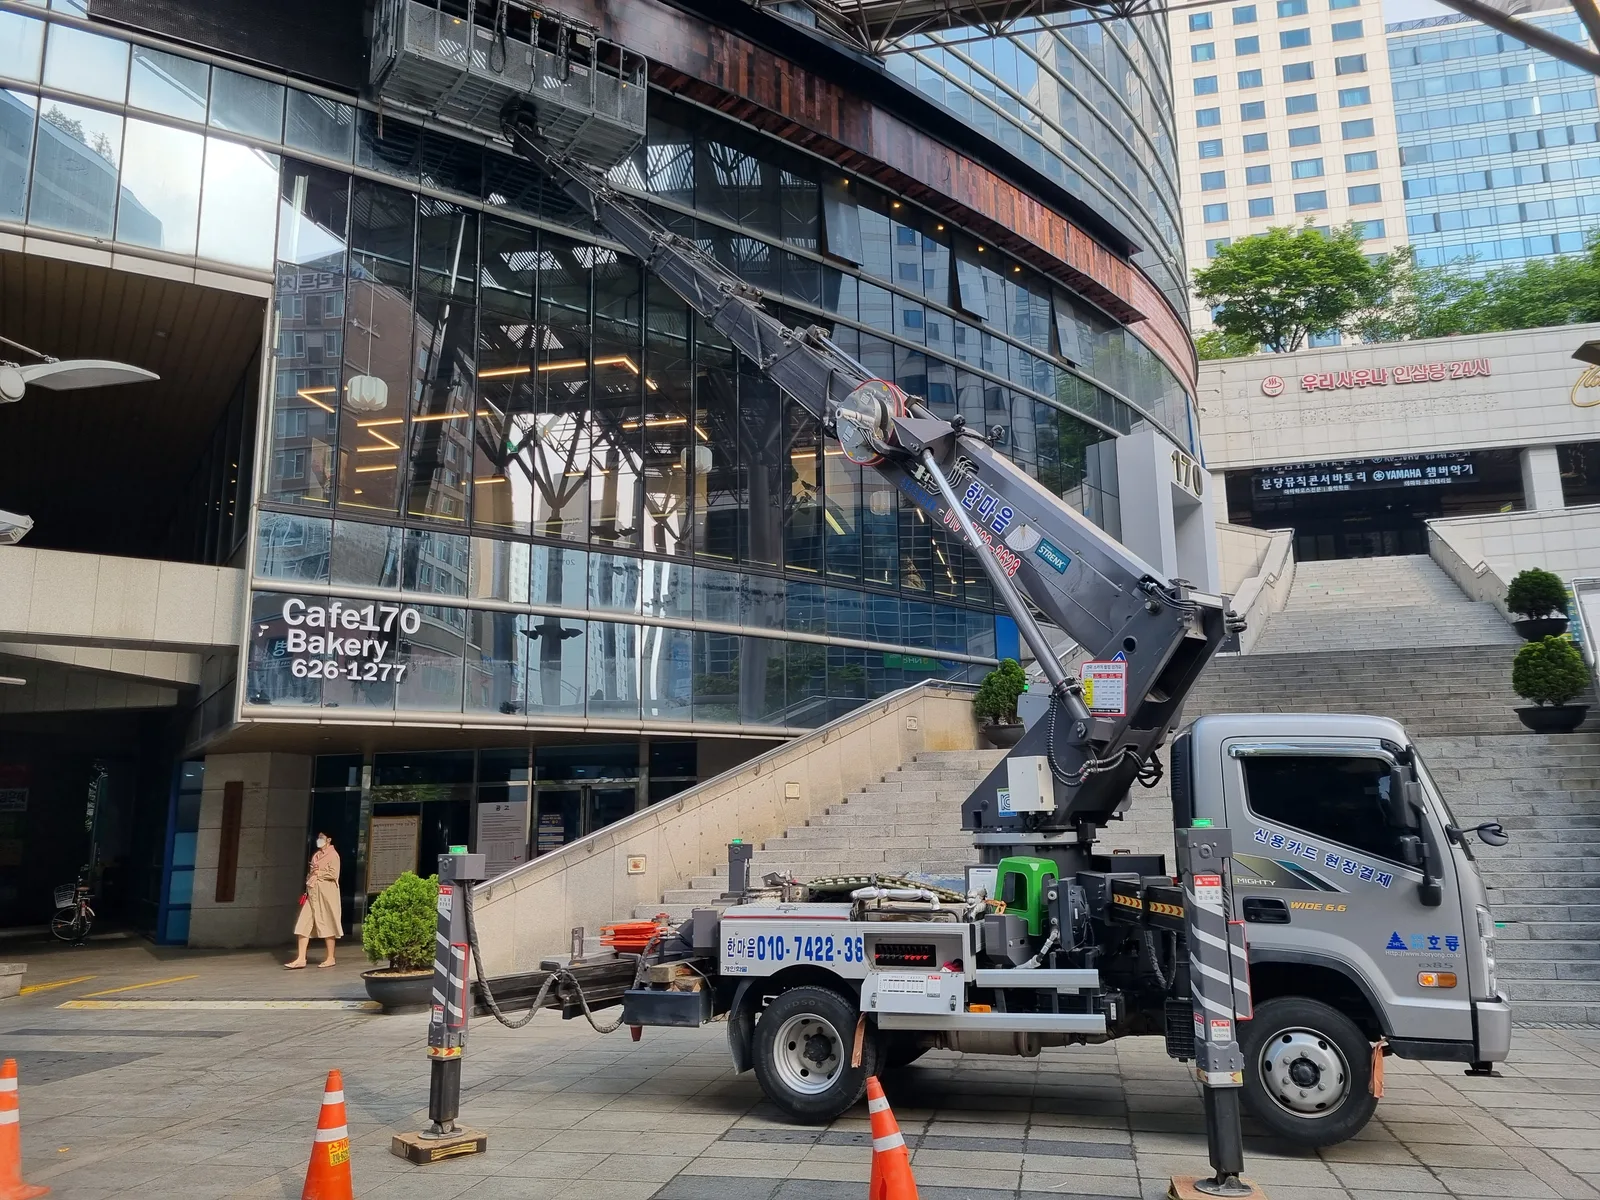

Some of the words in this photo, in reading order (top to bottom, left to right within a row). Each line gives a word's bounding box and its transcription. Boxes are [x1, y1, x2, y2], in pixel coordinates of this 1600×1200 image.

[1393, 362, 1446, 384] 인삼탕
[1450, 358, 1491, 380] 24시
[1170, 449, 1204, 497] 170
[1261, 471, 1367, 490] 분당뮤직콘서바토리
[1385, 468, 1422, 480] YAMAHA
[961, 481, 1015, 534] 한마음
[282, 598, 421, 634] Cafe170
[287, 628, 389, 663] Bakery
[291, 659, 407, 682] 626-1277
[1254, 827, 1319, 861] 신용카드
[1324, 852, 1393, 889] 현장결제
[1236, 877, 1276, 886] MIGHTY
[1290, 901, 1322, 911] WIDE
[1325, 903, 1347, 912] 6.6
[727, 937, 756, 958] 한마음
[1427, 935, 1460, 952] 호룡
